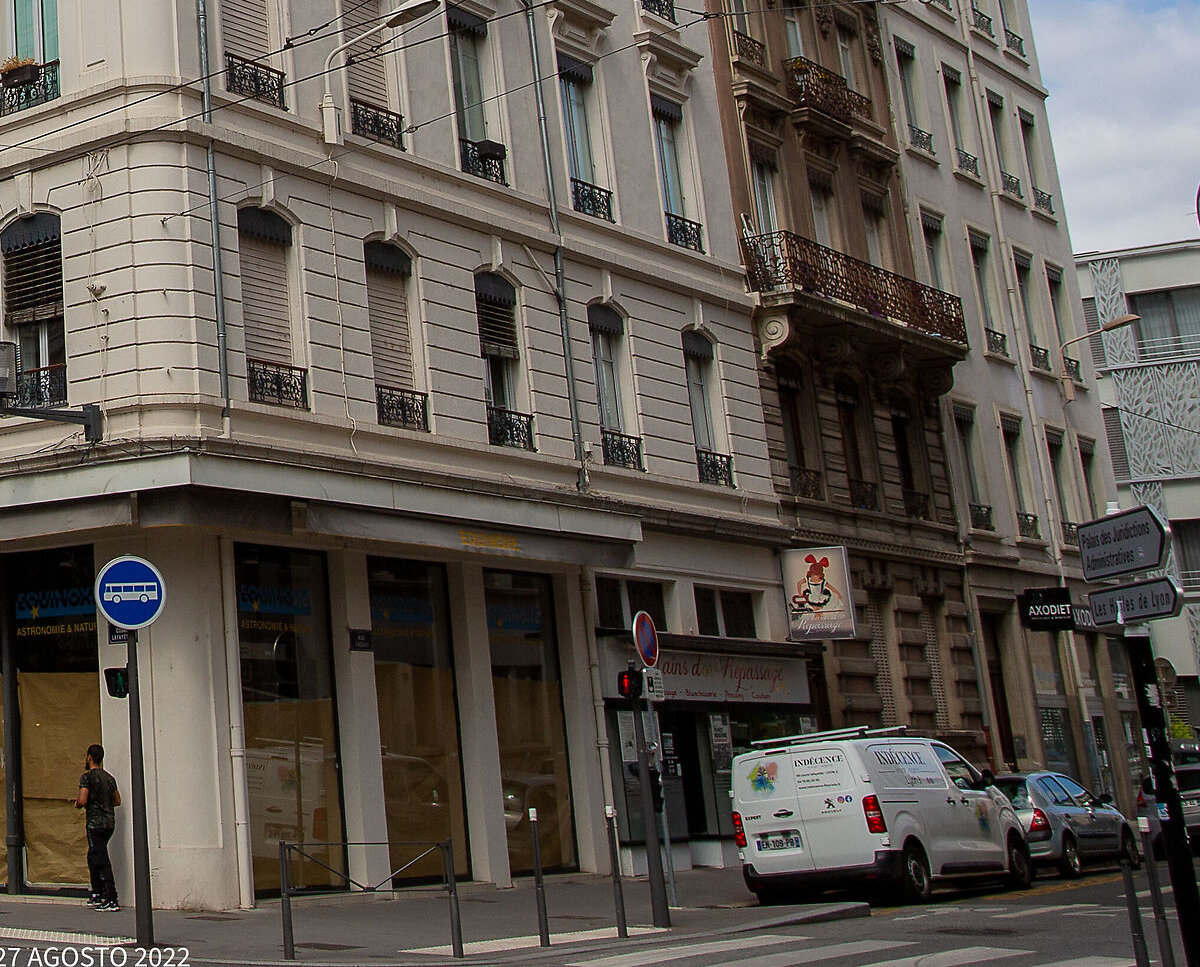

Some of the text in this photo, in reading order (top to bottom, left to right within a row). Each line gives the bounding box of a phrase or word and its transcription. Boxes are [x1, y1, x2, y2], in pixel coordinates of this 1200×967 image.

[1081, 520, 1150, 549] Palais des Juridictions
[1086, 548, 1134, 571] Administratives
[17, 587, 96, 611] EQUINOX
[1093, 600, 1106, 617] Les
[1138, 592, 1148, 609] de
[1150, 590, 1170, 611] Lyon
[1029, 604, 1072, 616] AXODIET
[16, 624, 66, 636] ASTRONOMIE
[67, 624, 72, 633] &
[794, 755, 843, 767] INDÉCENCE
[874, 748, 926, 764] INDÉCENCE
